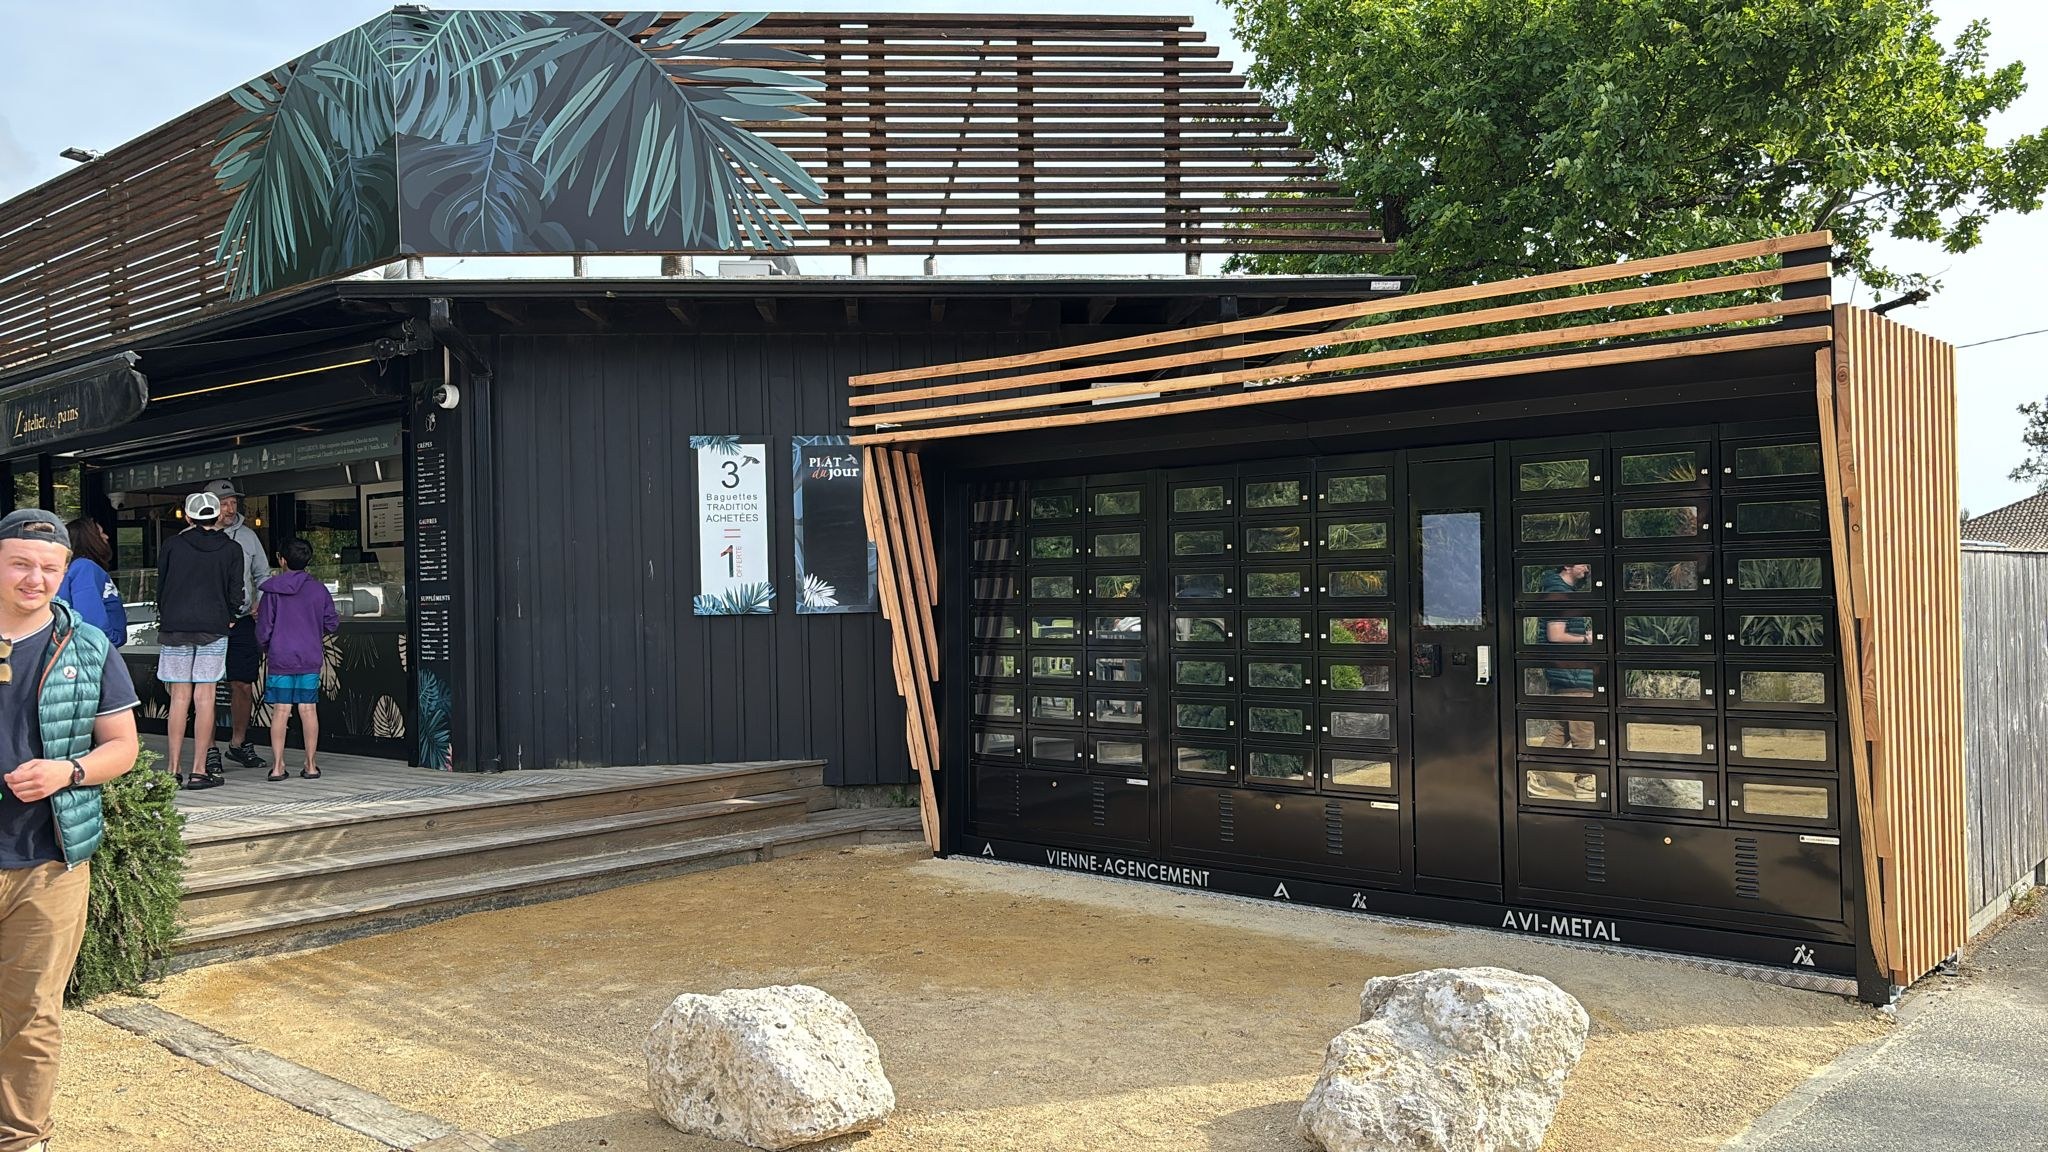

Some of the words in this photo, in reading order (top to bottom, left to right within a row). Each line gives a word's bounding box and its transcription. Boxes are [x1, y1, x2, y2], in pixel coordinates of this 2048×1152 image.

[13, 410, 46, 439] L'atelier
[57, 405, 79, 429] pains
[809, 456, 842, 468] PLAT
[721, 461, 740, 488] 3
[812, 467, 829, 479] du
[828, 468, 859, 480] jour
[706, 493, 758, 502] Baguettes
[706, 503, 758, 511] TRADITION
[706, 513, 759, 522] ACHETÉES
[720, 544, 734, 578] 1
[735, 546, 743, 578] OFFERTE
[1728, 688, 1736, 696] 57
[1046, 849, 1210, 888] VIENNE-AGENCEMENT
[1502, 911, 1621, 941] AVI-METAL
